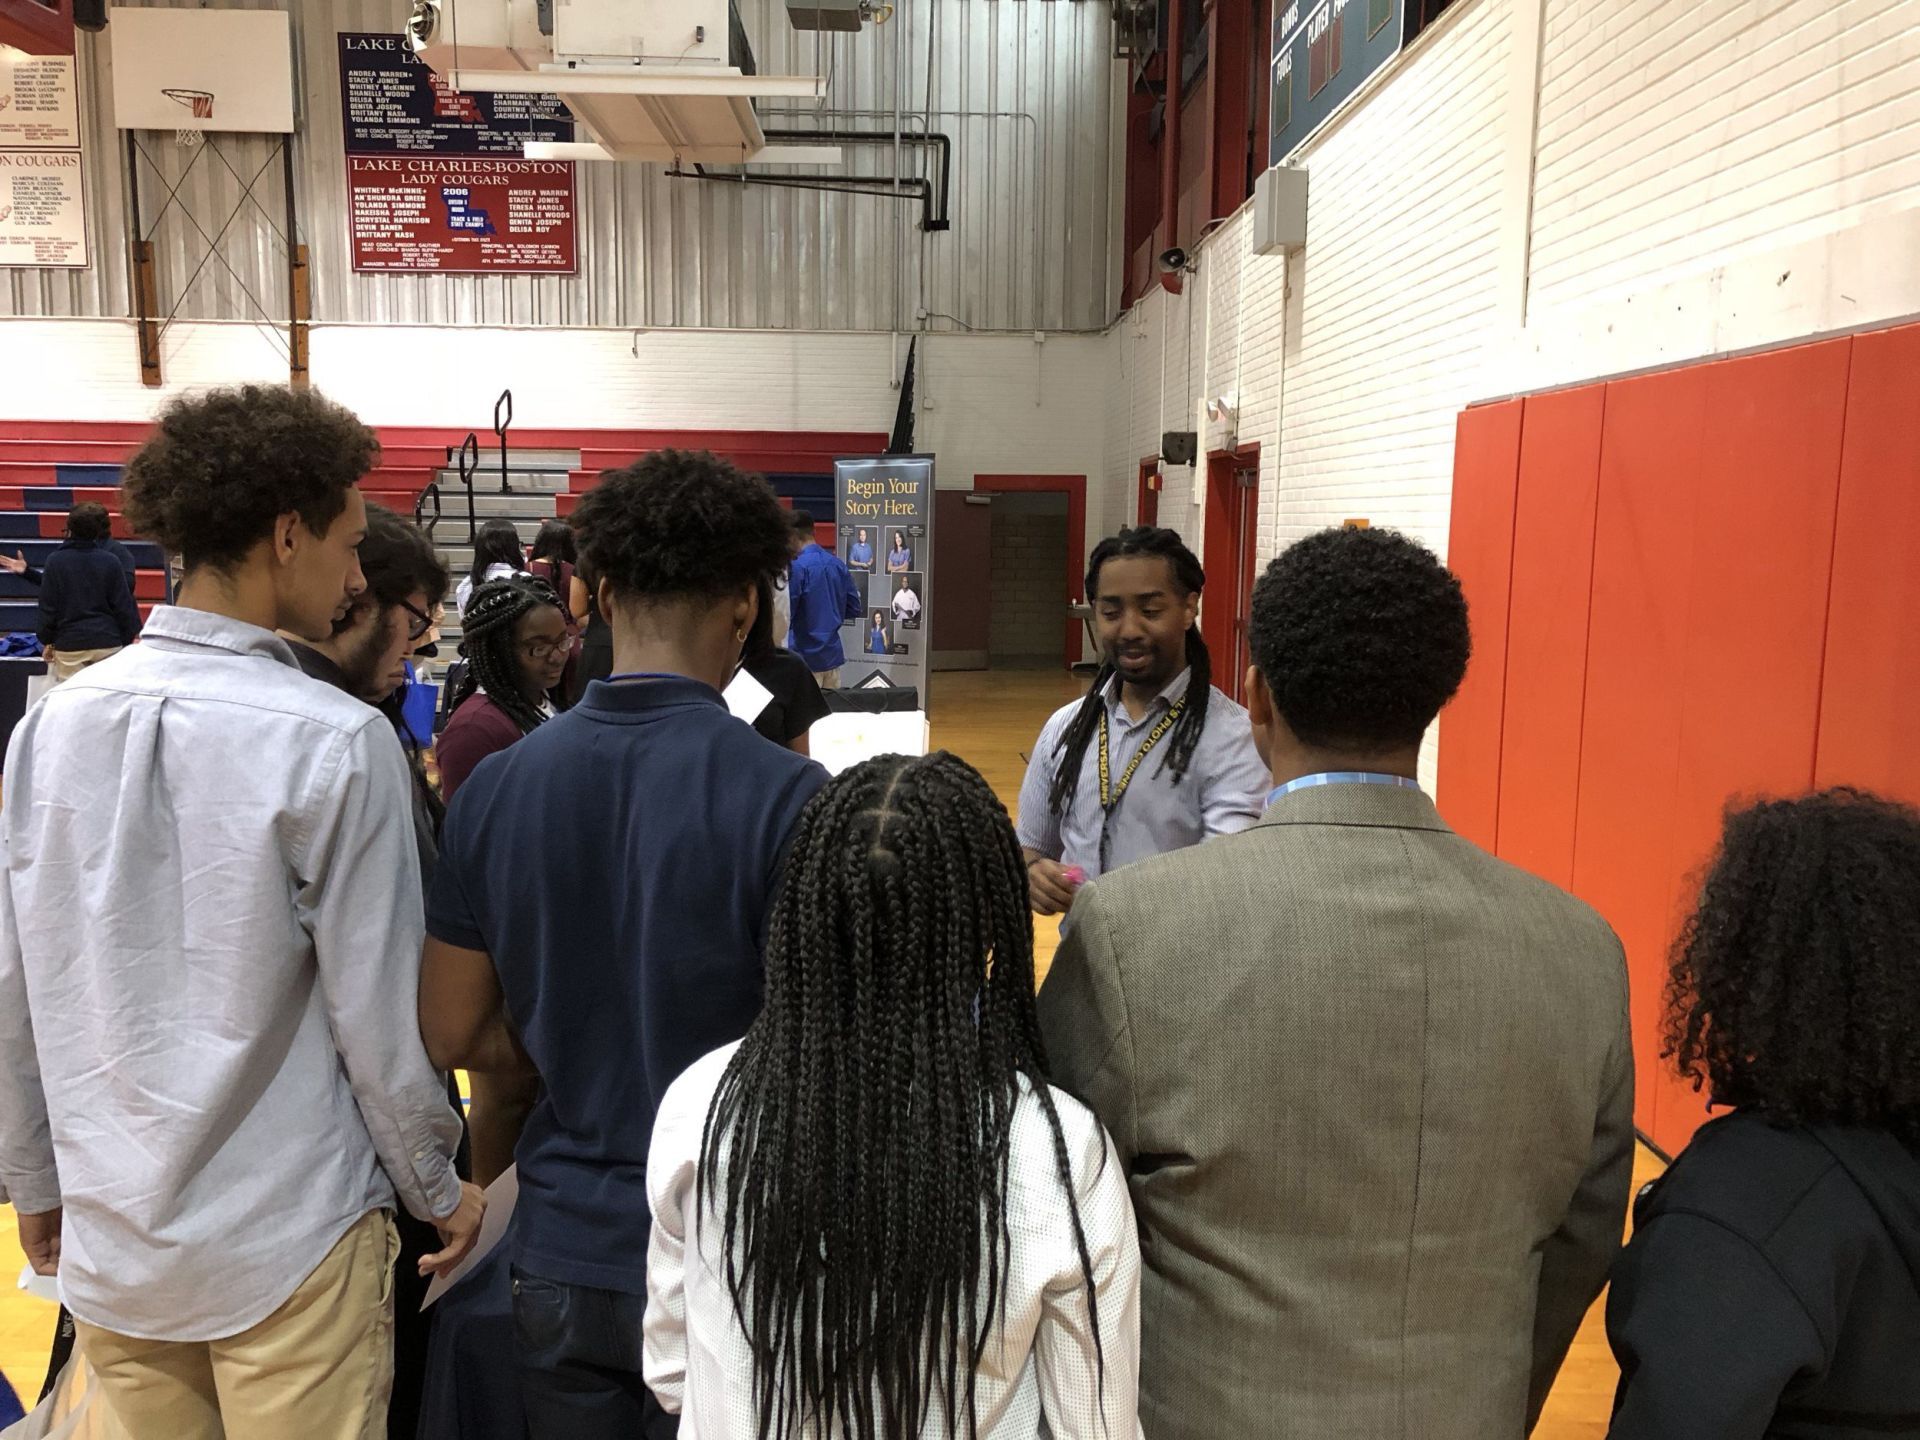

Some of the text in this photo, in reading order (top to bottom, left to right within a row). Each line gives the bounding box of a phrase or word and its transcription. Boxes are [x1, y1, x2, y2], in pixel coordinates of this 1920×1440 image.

[1307, 2, 1330, 48] PLAYER
[346, 38, 396, 50] LAKE
[402, 54, 421, 64] LA
[1276, 48, 1292, 84] FOULS
[430, 74, 448, 82] 20
[16, 155, 77, 167] COUGARS
[353, 160, 568, 174] LAKE CHARLES-BOSTON
[401, 174, 509, 185] LADY COUGARS
[848, 478, 919, 499] Begin Your
[845, 500, 918, 519] Story Here.
[1142, 717, 1172, 753] PHOTO
[62, 1314, 73, 1338] NIKE
